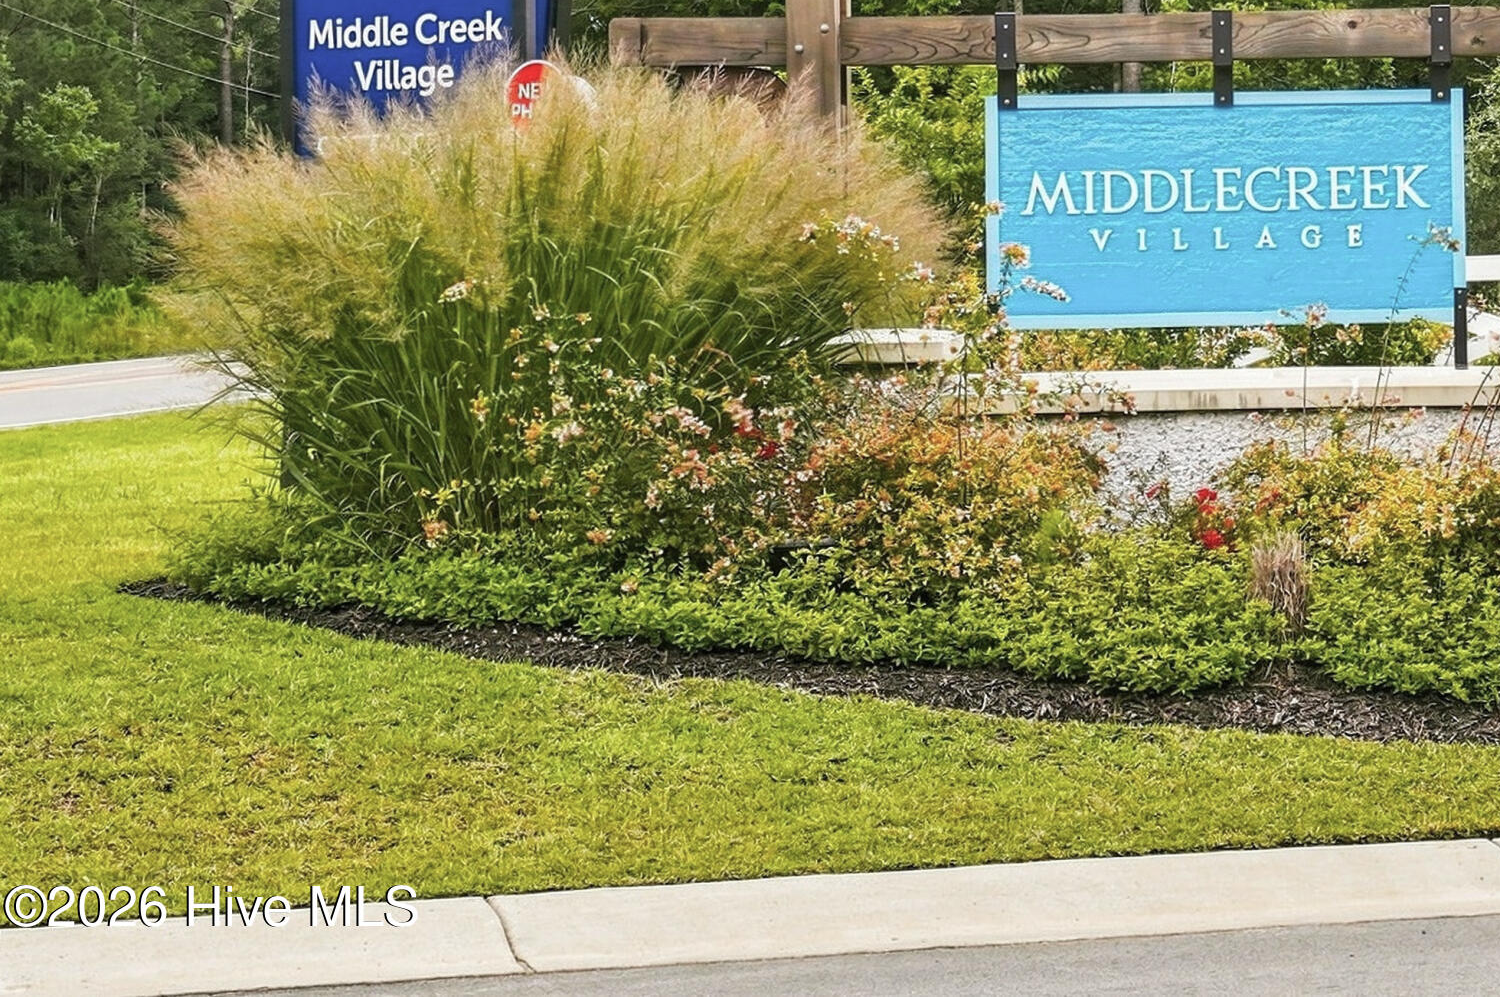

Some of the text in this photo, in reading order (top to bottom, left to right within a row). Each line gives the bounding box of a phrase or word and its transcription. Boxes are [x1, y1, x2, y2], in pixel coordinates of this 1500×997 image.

[308, 10, 503, 50] Middle Creek
[354, 59, 454, 96] Village
[1020, 164, 1431, 217] MIDDLECREEK
[1088, 223, 1364, 252] VILLAGE
